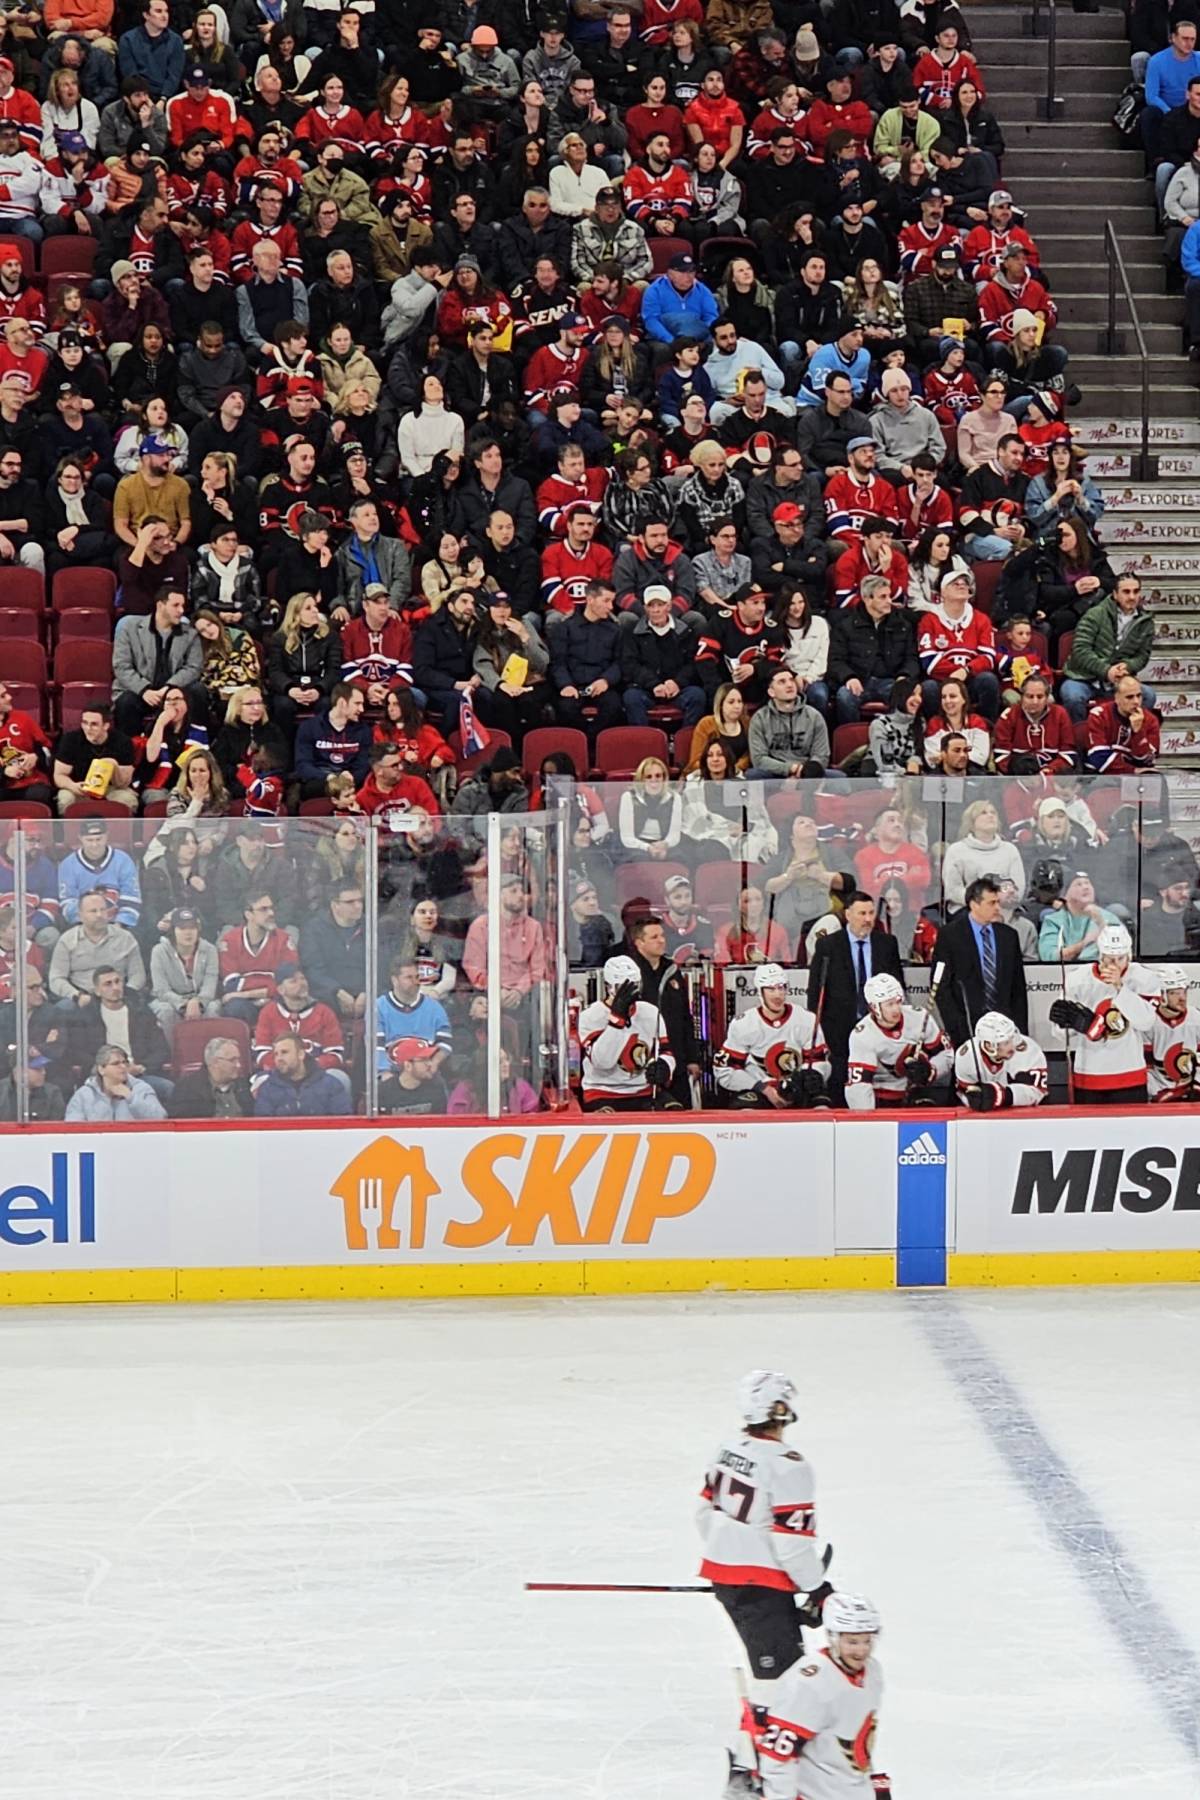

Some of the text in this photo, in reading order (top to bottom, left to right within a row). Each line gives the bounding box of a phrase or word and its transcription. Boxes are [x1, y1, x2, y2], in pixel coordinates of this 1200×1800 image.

[442, 1132, 717, 1249] SKIP
[898, 1152, 946, 1165] adidas
[0, 1151, 96, 1246] ell
[760, 1723, 799, 1756] 26
